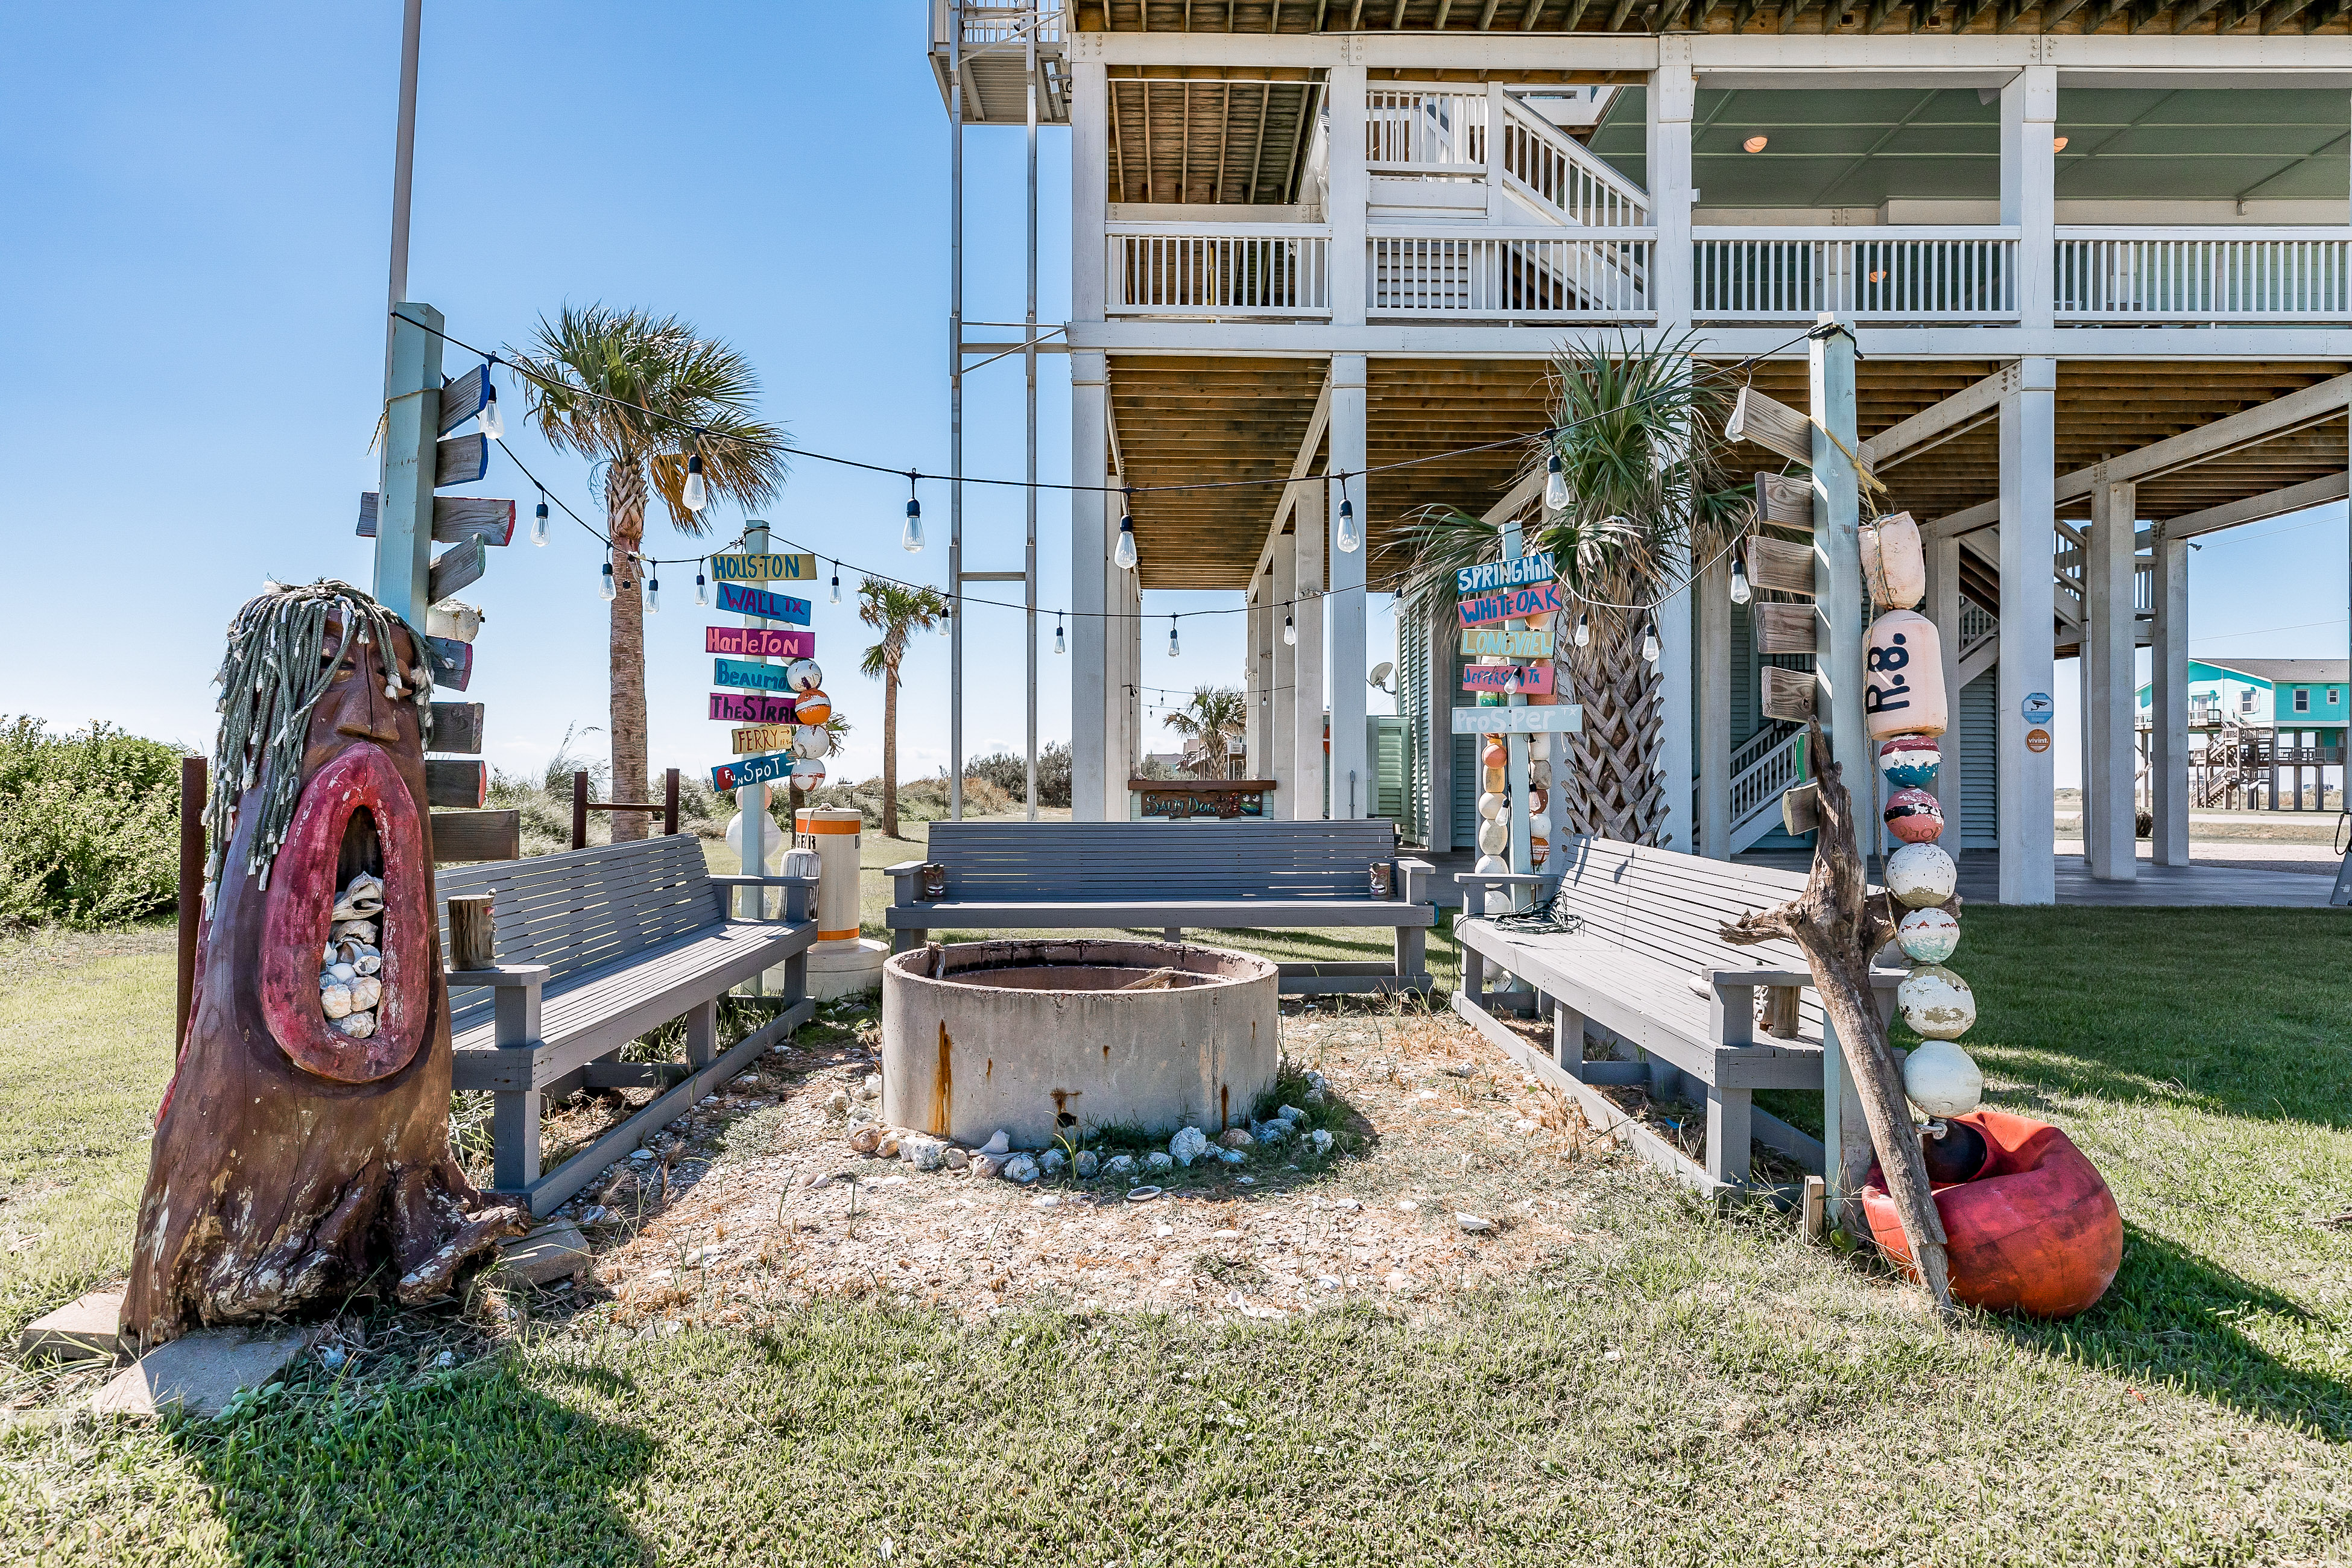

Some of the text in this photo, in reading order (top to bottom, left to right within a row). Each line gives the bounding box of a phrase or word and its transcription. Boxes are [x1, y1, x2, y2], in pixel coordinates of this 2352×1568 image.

[712, 555, 800, 579] HOUSTON
[724, 585, 805, 616] WALL TX
[1560, 707, 1579, 716] TX
[738, 729, 777, 752] FERRY
[1188, 797, 1215, 812] DOG
